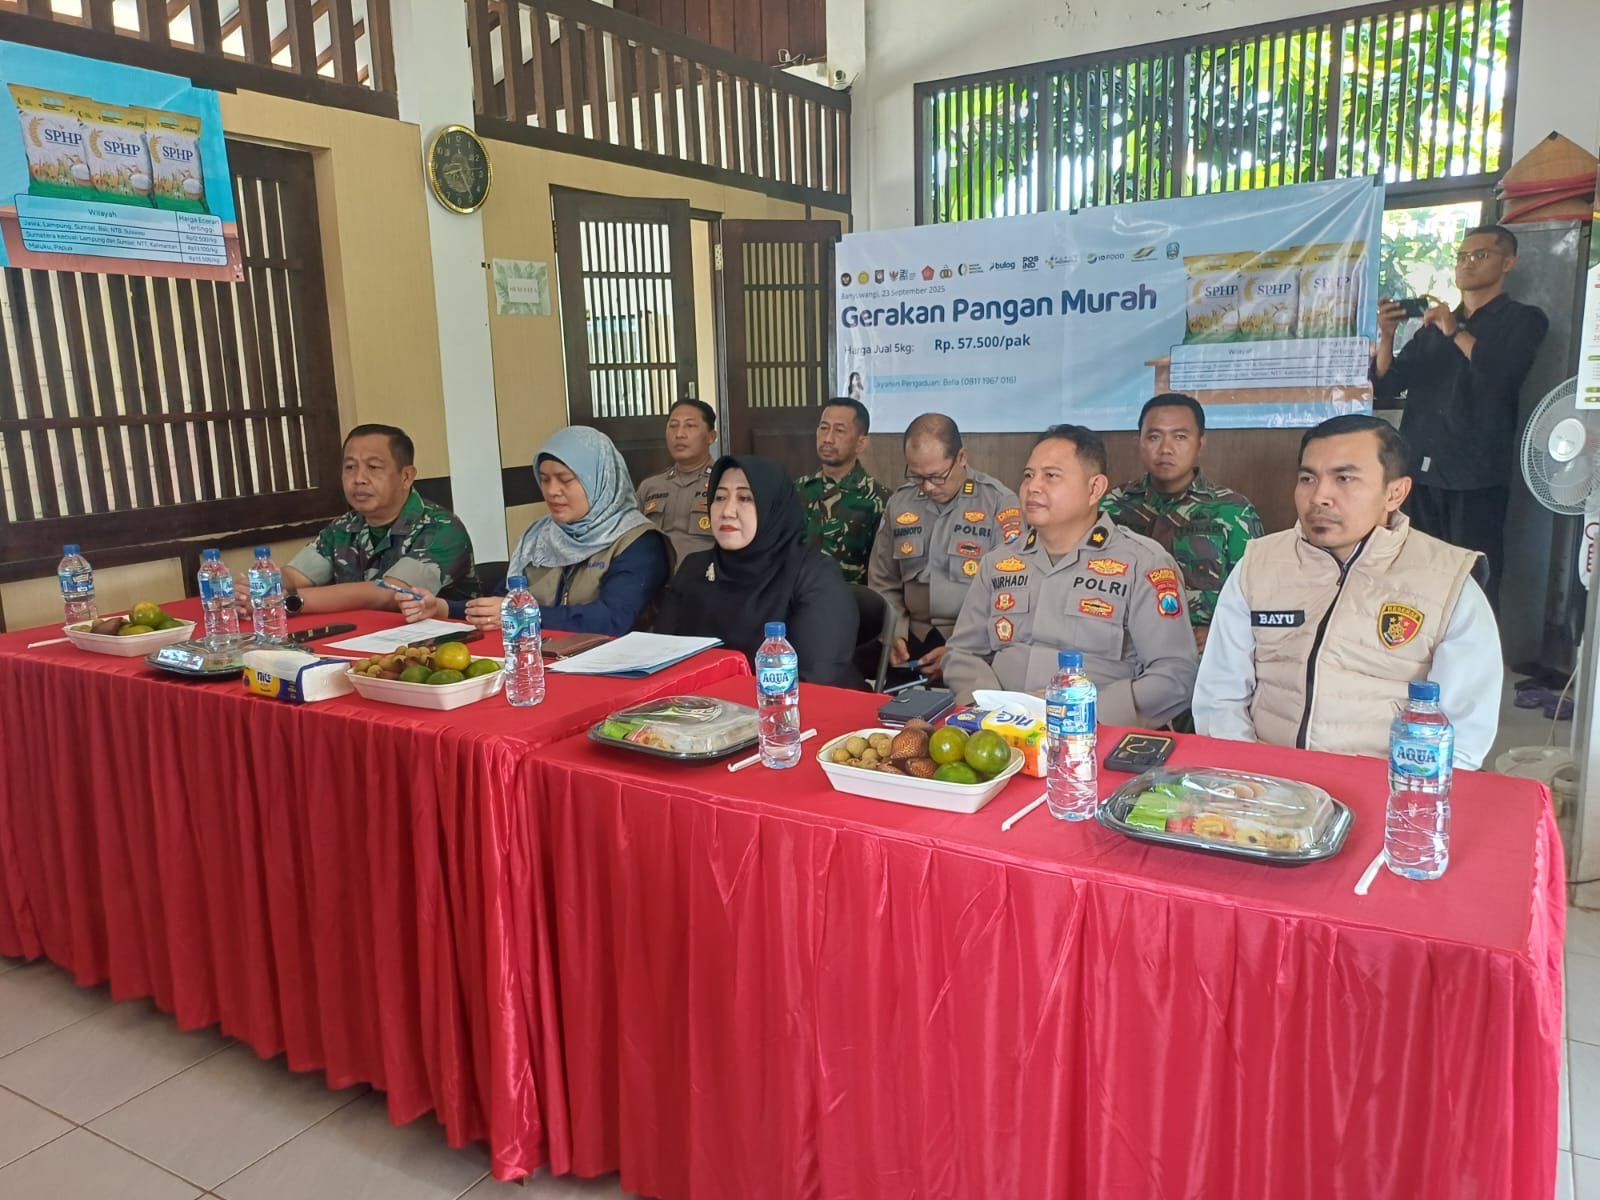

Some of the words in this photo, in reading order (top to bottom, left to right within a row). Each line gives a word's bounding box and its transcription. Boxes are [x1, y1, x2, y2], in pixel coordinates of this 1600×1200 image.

[44, 128, 82, 145] SPHP
[103, 140, 141, 156] SPHP
[161, 145, 193, 161] SPHP
[87, 208, 117, 218] Wilayah
[994, 260, 1016, 270] bulog
[1257, 283, 1292, 295] SPHP
[1314, 276, 1351, 290] SPP
[881, 289, 890, 297] 23
[891, 286, 927, 298] September
[928, 285, 946, 294] 2025
[1204, 284, 1239, 297] SPHP
[841, 301, 945, 329] Gerakan
[952, 296, 1053, 326] Pangan
[1061, 283, 1157, 315] Murah
[873, 343, 892, 355] Jual
[894, 343, 915, 355] 5kg:
[934, 338, 954, 353] Rp.
[957, 333, 1031, 350] 57.500/pak
[953, 523, 991, 537] POLRI
[991, 574, 1029, 590] NURHADI
[1073, 577, 1128, 598] POLRI
[1258, 613, 1295, 625] BAYU
[762, 672, 790, 684] AQUA
[1396, 746, 1437, 765] AQUA
